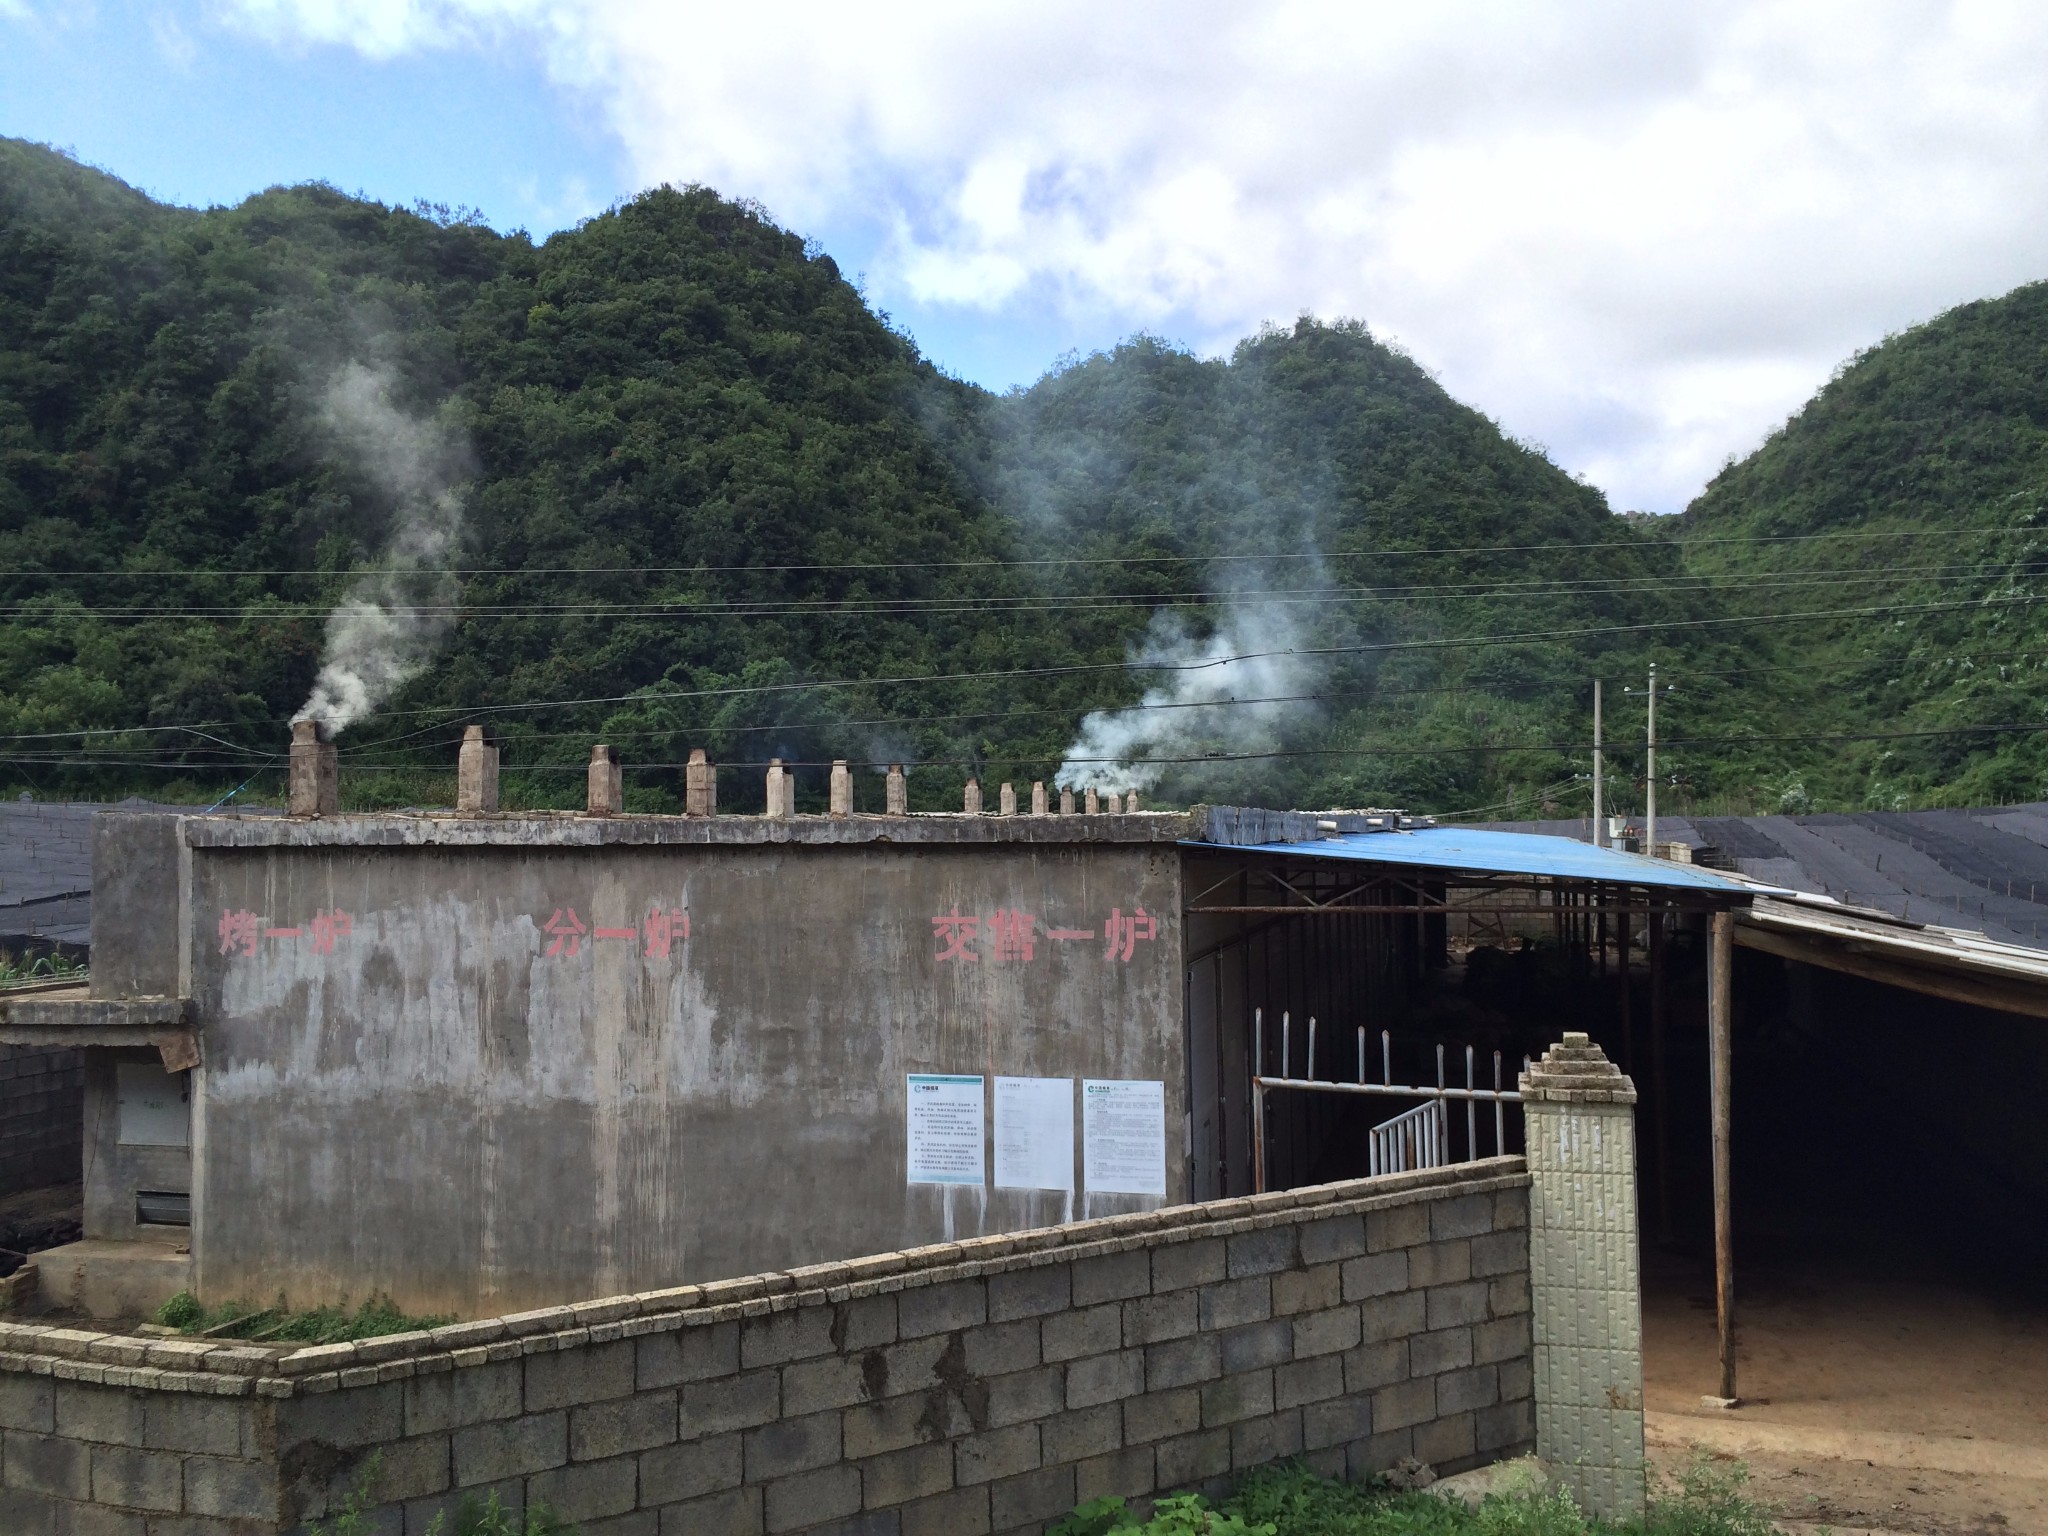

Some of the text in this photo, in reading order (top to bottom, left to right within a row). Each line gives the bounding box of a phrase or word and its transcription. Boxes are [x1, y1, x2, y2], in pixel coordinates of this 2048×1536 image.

[218, 907, 1156, 961] 烤一炉 分一炉 交售一炉
